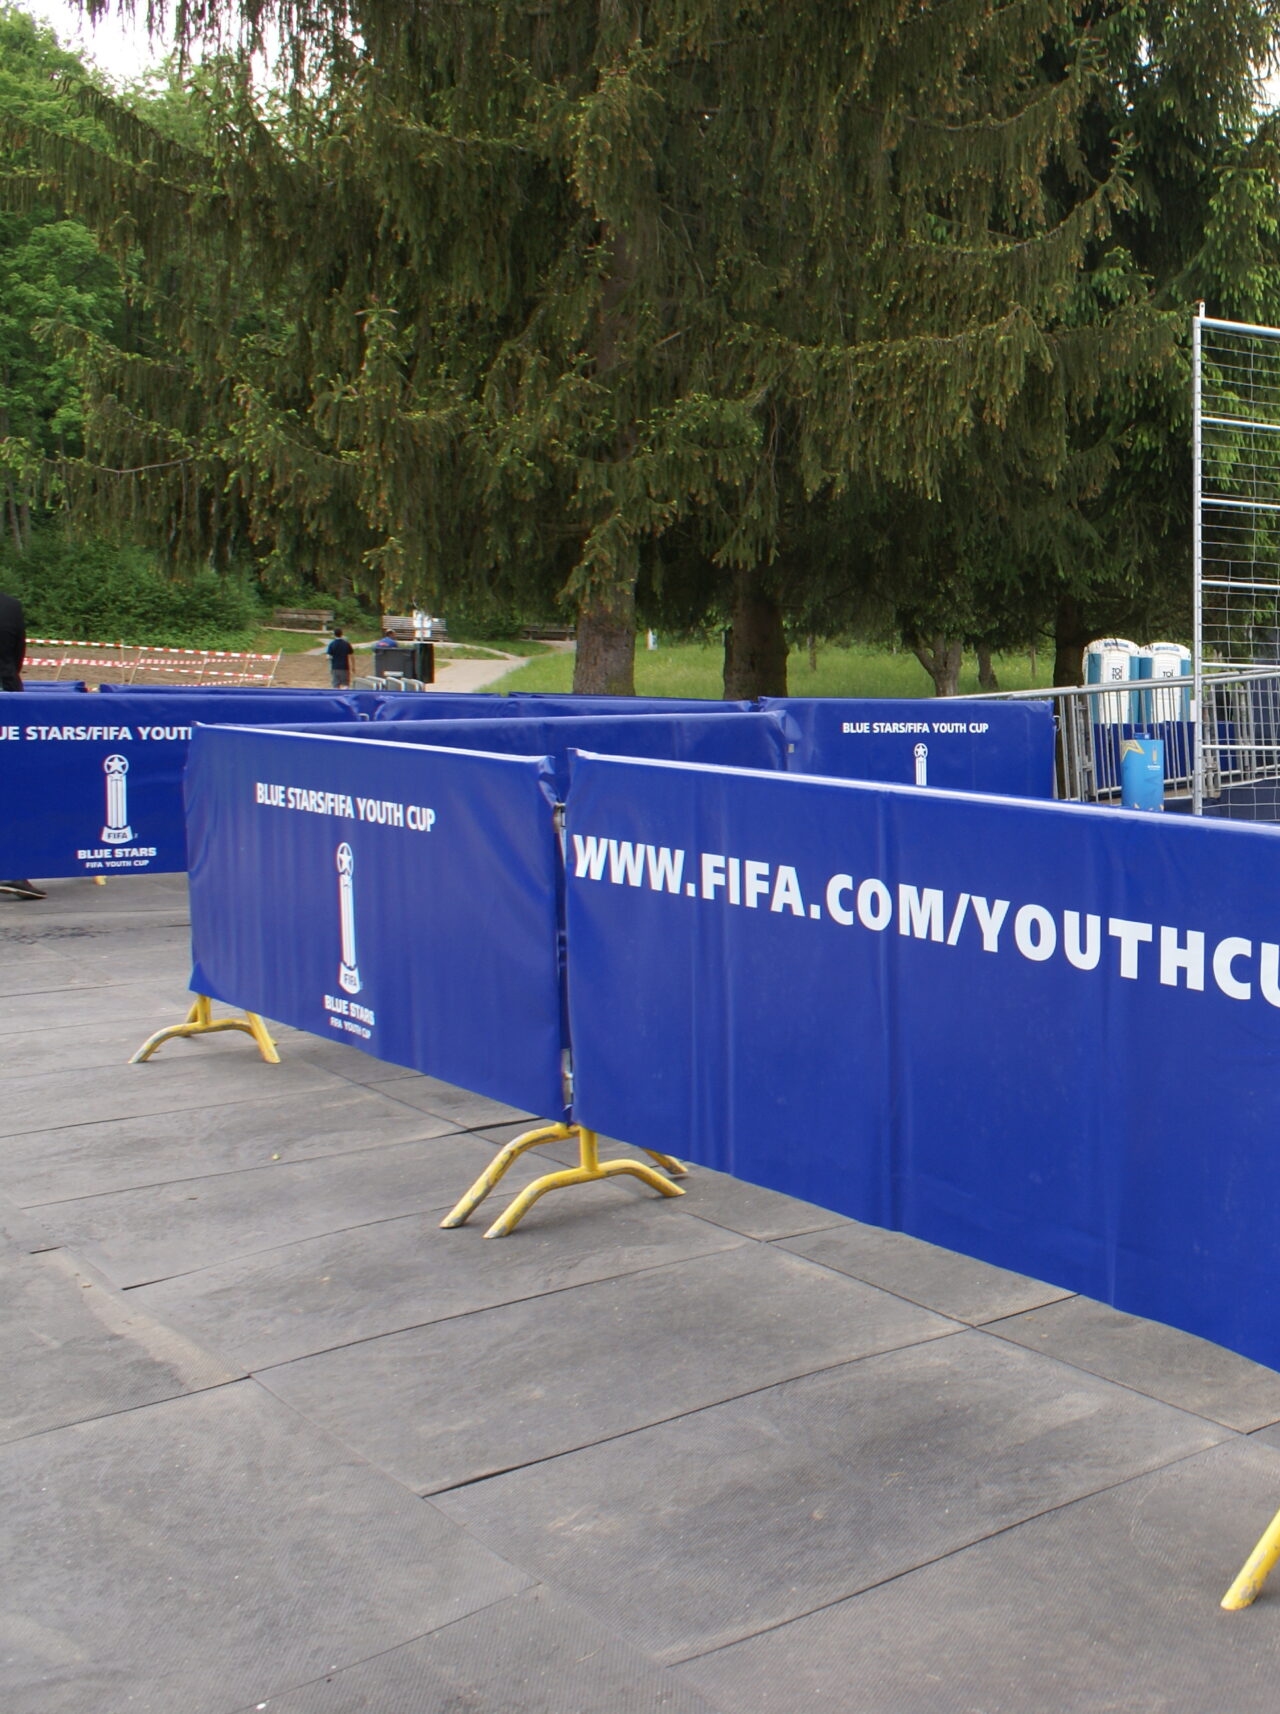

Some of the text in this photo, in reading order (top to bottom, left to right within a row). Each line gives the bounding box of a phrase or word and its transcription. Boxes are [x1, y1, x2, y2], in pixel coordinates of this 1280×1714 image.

[26, 726, 133, 740] STARS/FIFA
[139, 726, 192, 740] YOUT
[842, 722, 989, 733] BLUE STARS/FIFA YOUTH CUP
[256, 782, 436, 832] BLUE STARS/FIFA YOUTH CUP
[107, 832, 128, 840] FIFA
[77, 847, 157, 860] BLUE STARS
[324, 994, 375, 1026] BLUE STARS
